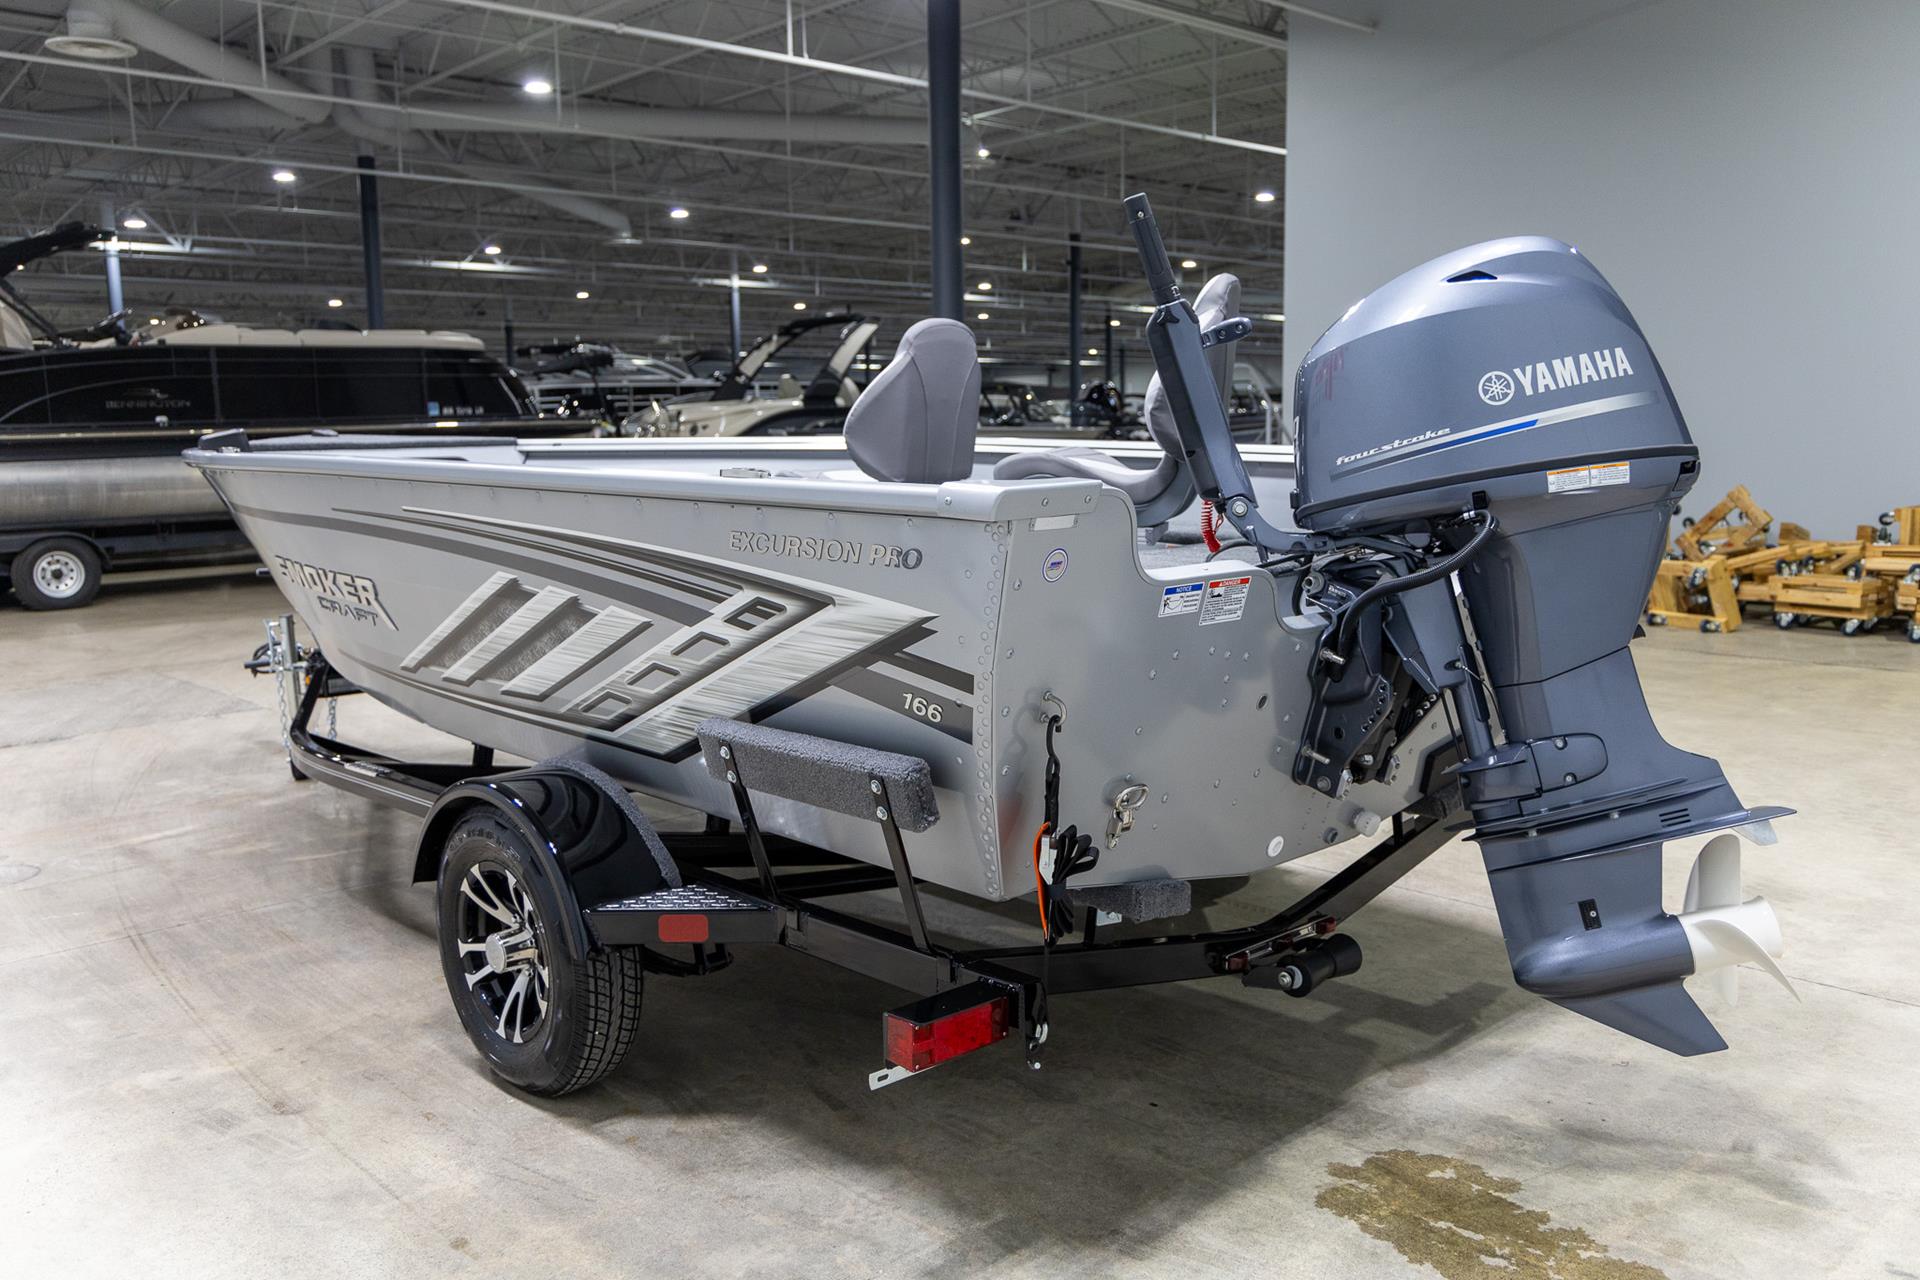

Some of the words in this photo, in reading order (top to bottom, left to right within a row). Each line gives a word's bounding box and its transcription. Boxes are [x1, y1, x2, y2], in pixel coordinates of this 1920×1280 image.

[1513, 347, 1634, 396] YAMAHA
[729, 530, 862, 564] EXCURSION
[868, 544, 923, 570] PRO
[1176, 585, 1192, 593] NOTICE
[317, 595, 378, 627] CRAFT
[902, 692, 944, 723] 166
